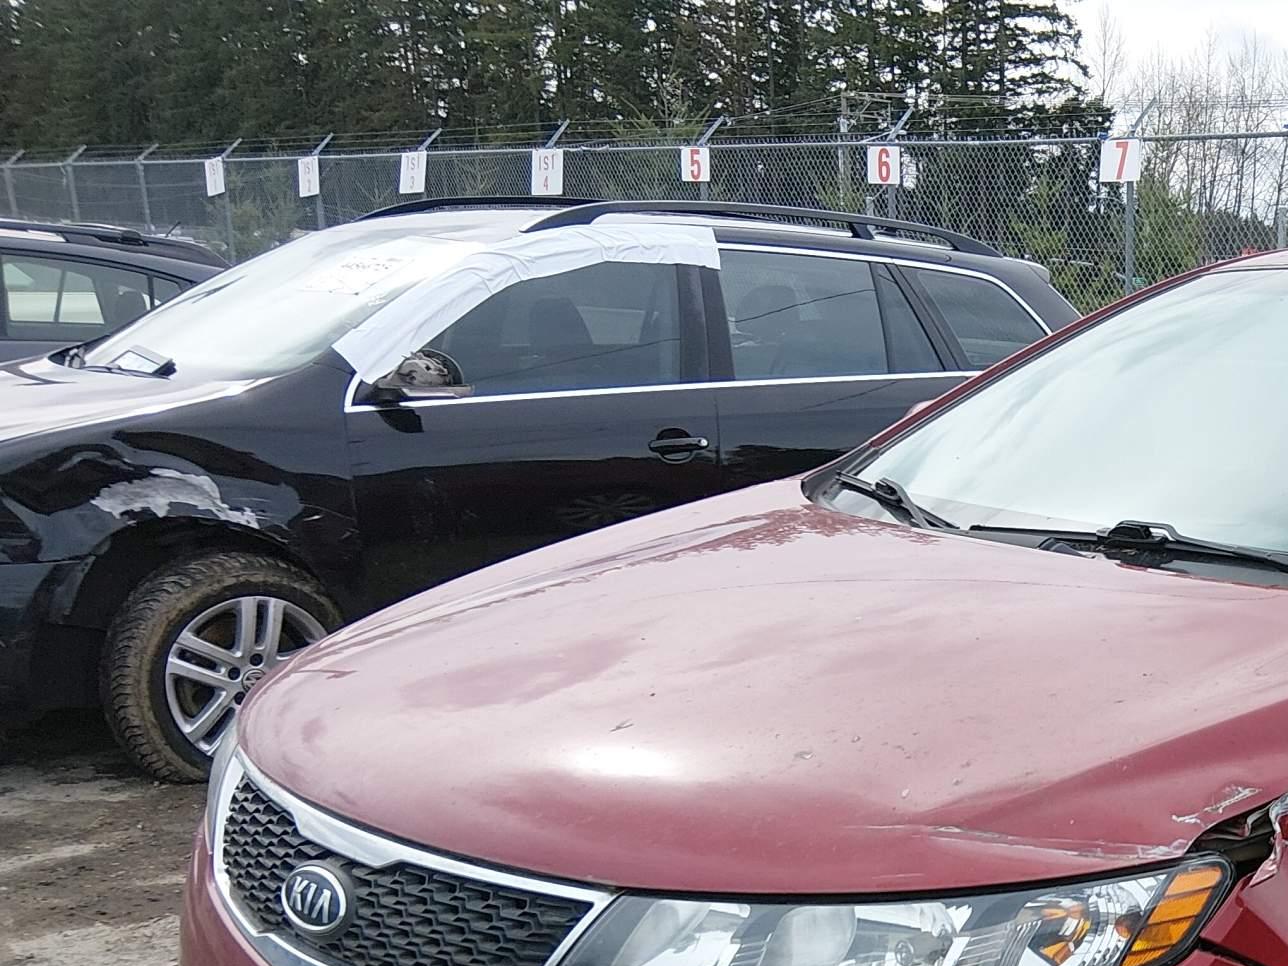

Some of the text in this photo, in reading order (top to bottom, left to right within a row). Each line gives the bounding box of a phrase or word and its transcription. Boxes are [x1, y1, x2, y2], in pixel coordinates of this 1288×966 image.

[690, 149, 700, 180] 5
[877, 147, 891, 182] 6
[1115, 141, 1129, 180] 7
[543, 175, 549, 191] 4
[289, 876, 331, 924] KIA
